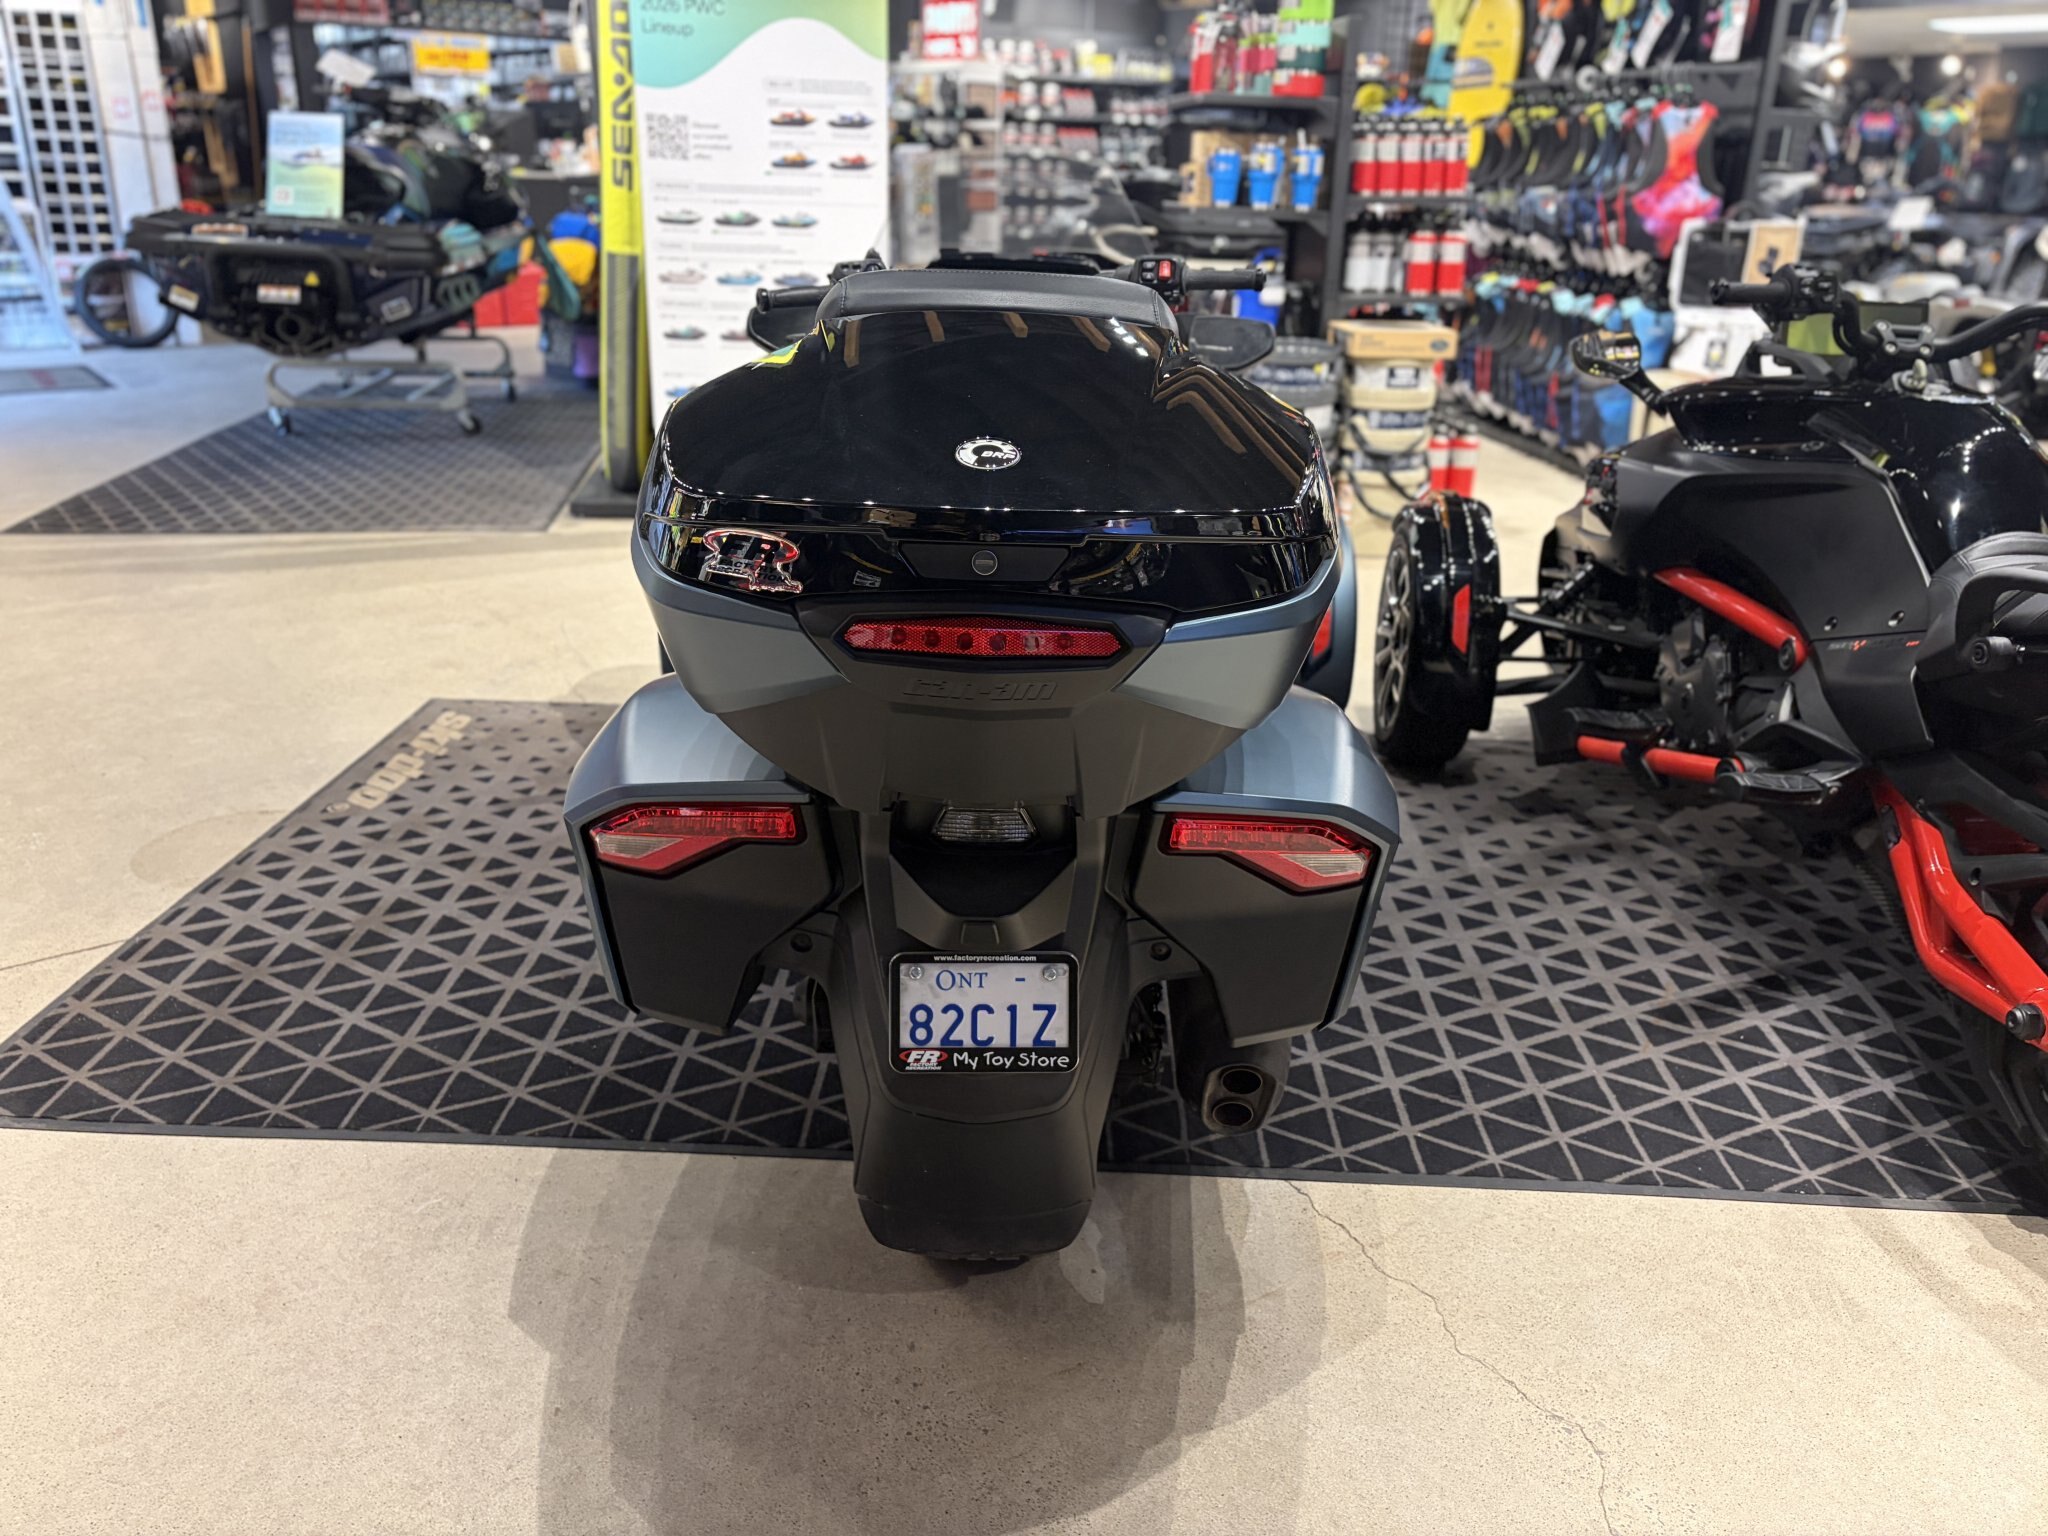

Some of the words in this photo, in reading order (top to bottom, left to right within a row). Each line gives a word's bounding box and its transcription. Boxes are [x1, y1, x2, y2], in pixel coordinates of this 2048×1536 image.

[641, 18, 695, 37] Lineup
[934, 955, 1037, 963] www.factoryrecreation.com
[935, 969, 988, 991] ONT
[909, 1003, 1057, 1047] 82C1Z
[907, 1050, 940, 1063] FR
[953, 1052, 978, 1070] My
[983, 1051, 1015, 1069] Toy
[1017, 1052, 1070, 1068] Store
